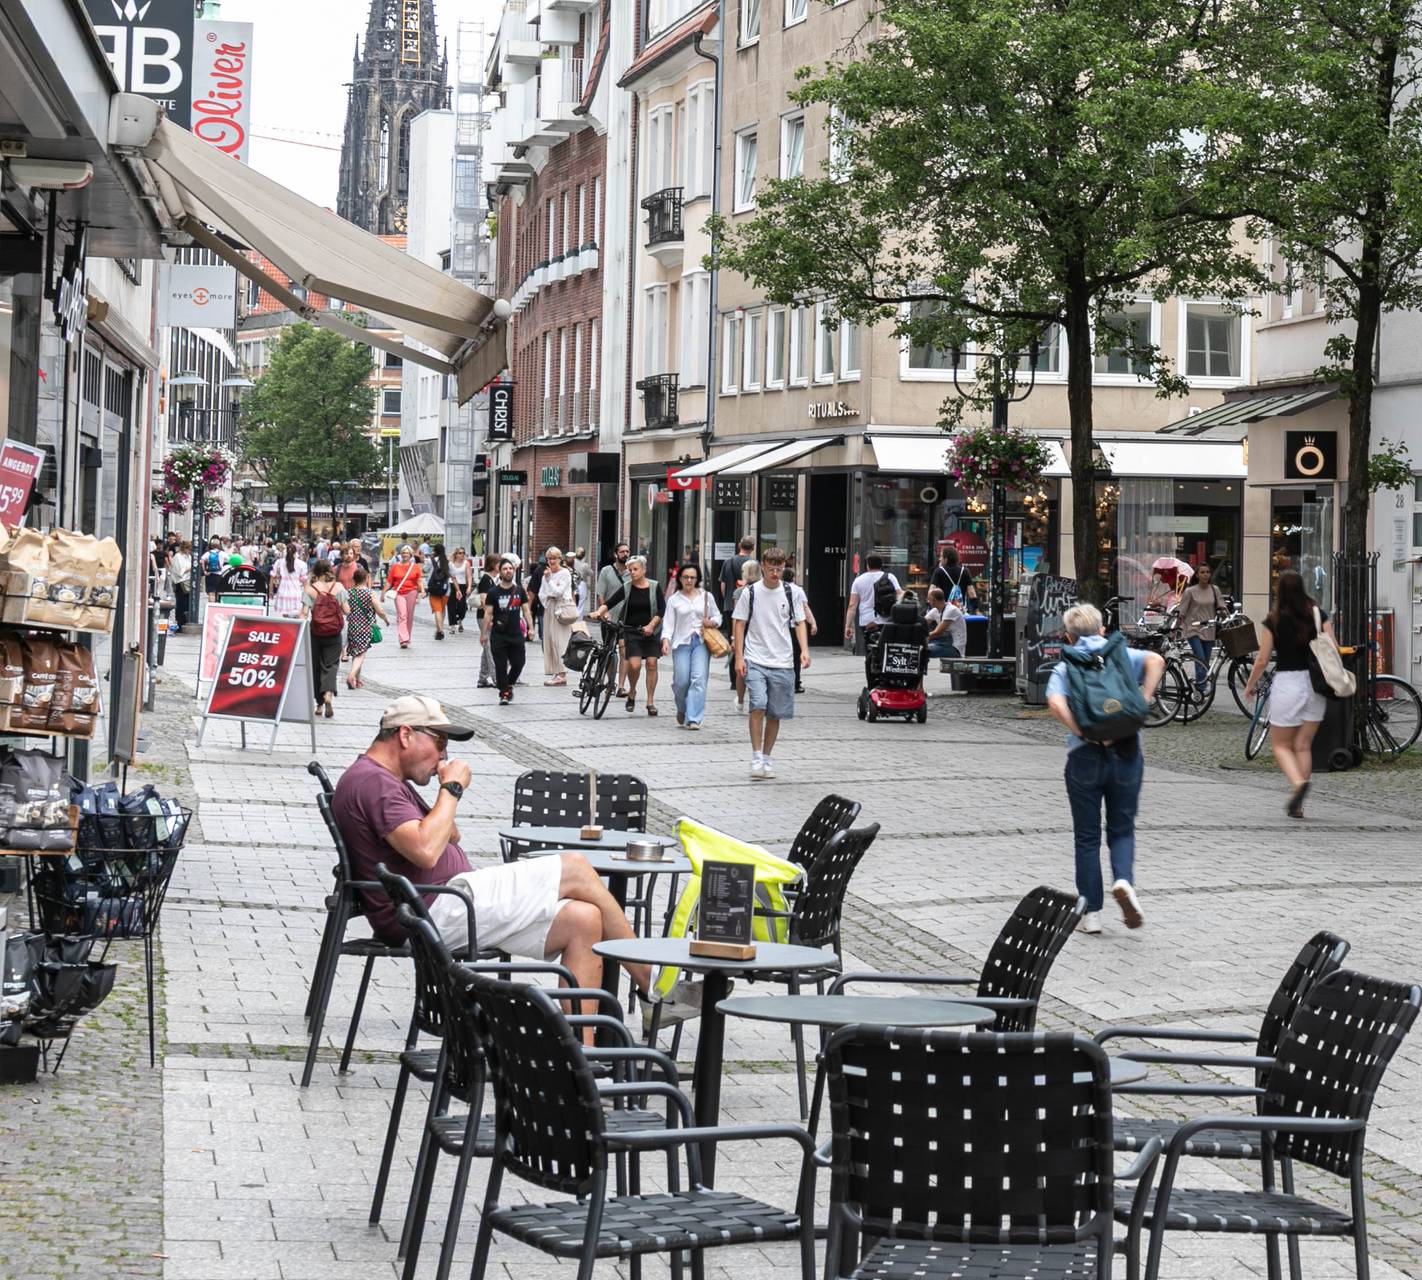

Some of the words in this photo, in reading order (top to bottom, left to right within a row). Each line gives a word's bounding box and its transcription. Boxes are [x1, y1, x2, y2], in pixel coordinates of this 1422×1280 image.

[172, 292, 192, 300] eyes
[209, 292, 232, 300] more
[494, 390, 508, 433] CHRIST
[2, 457, 34, 475] ANGEBOT
[1396, 494, 1404, 508] 28
[248, 631, 280, 644] SALE
[238, 653, 258, 664] BIS
[261, 654, 278, 666] ZU
[228, 667, 276, 688] 50%
